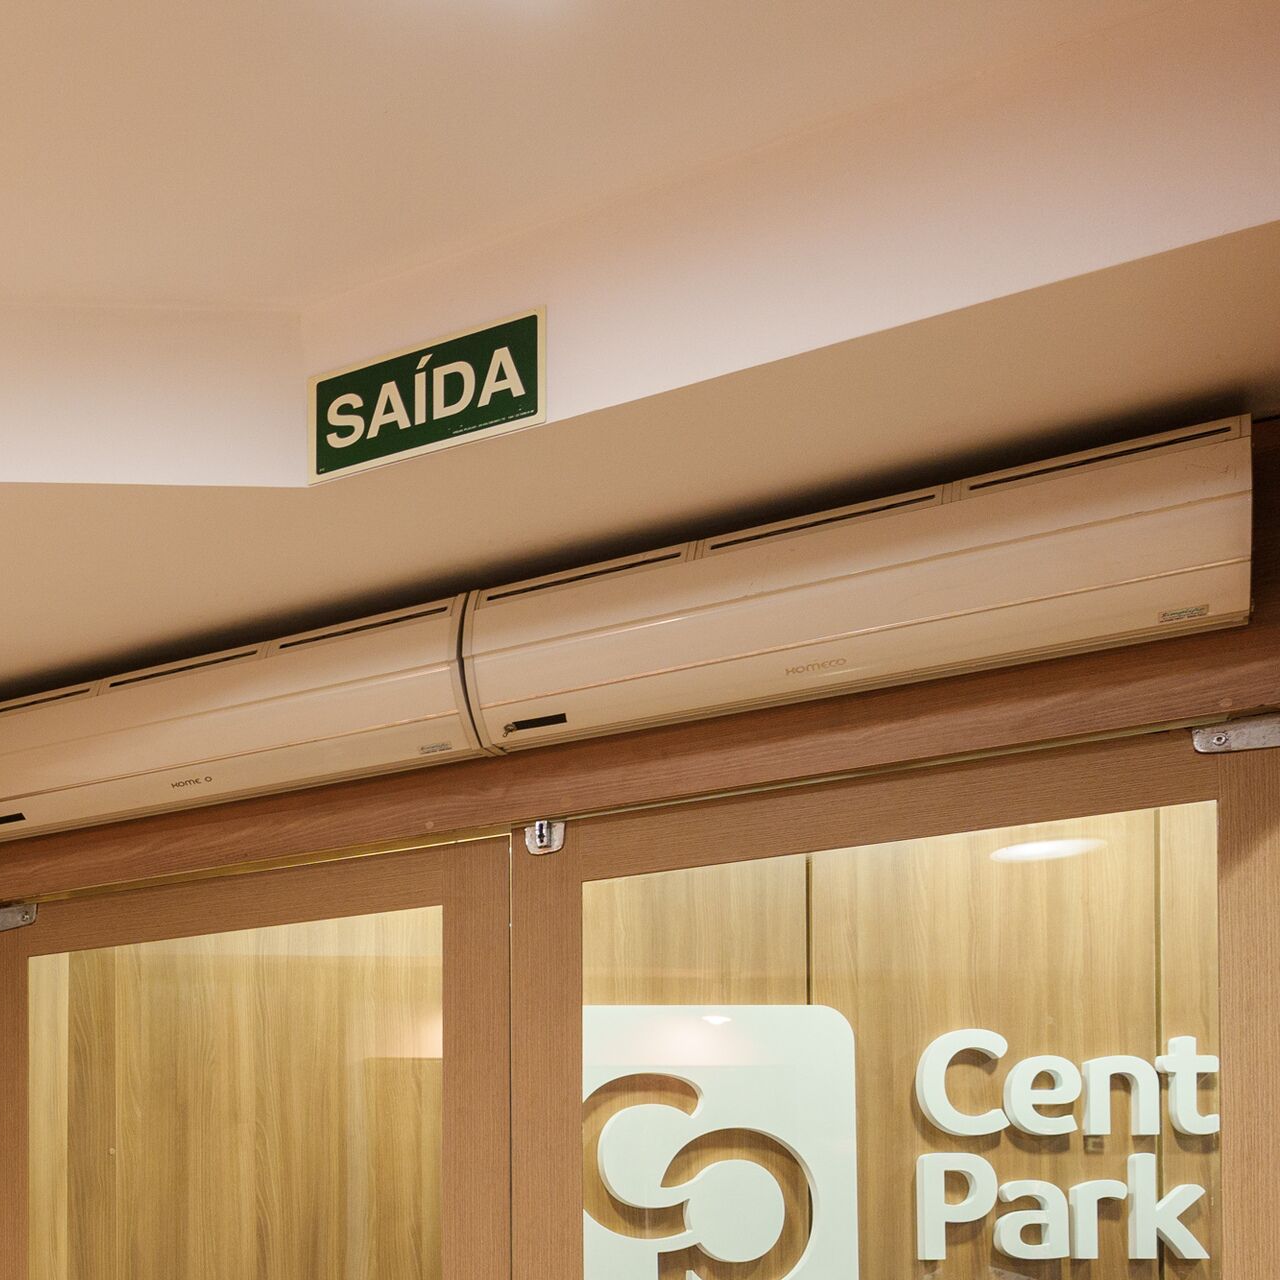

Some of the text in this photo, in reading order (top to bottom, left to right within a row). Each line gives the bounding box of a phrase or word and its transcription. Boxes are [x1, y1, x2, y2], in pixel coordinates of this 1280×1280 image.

[326, 346, 526, 449] SAÍDA
[915, 1028, 1220, 1137] Cent
[916, 1152, 1210, 1260] Park
